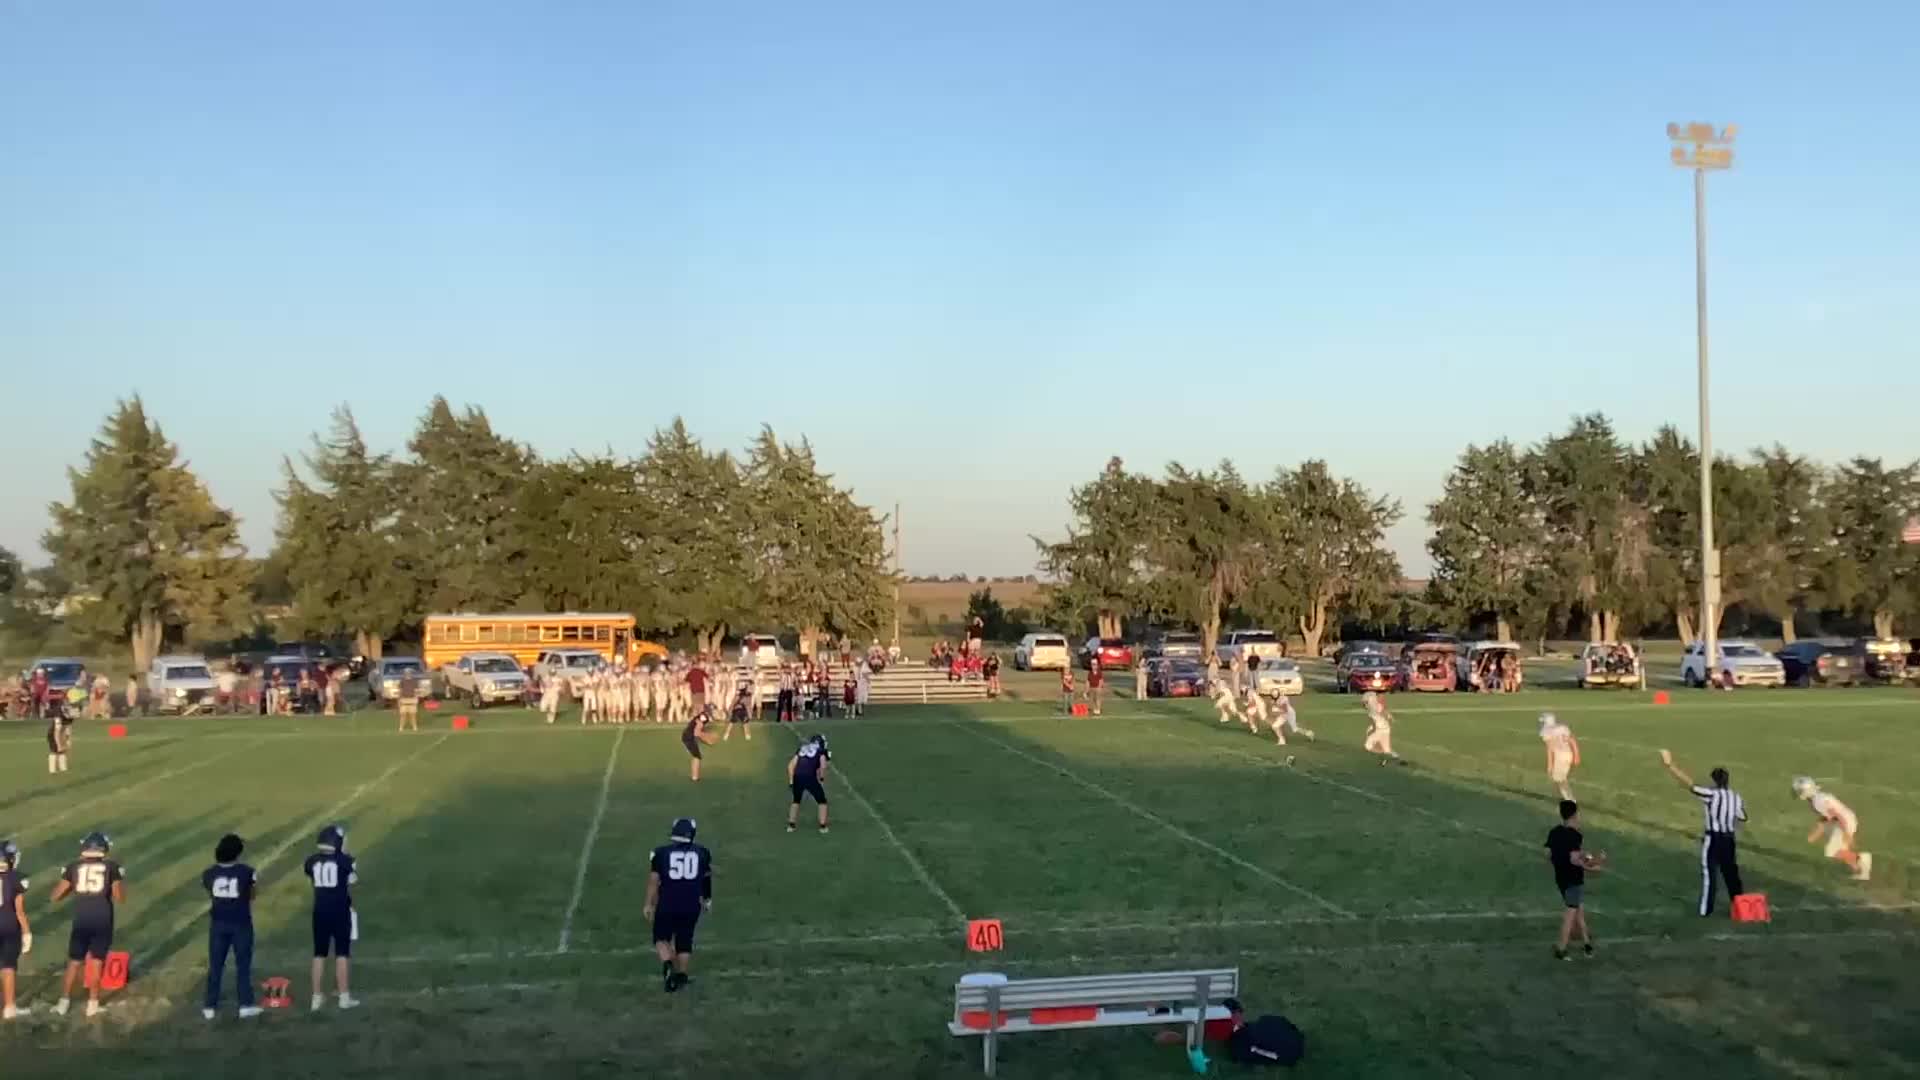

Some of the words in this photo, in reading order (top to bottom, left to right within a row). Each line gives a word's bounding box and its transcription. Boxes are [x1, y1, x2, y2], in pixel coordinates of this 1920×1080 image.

[76, 863, 107, 893] 15
[312, 861, 338, 888] 10
[669, 851, 699, 880] 50
[976, 924, 1000, 950] 40
